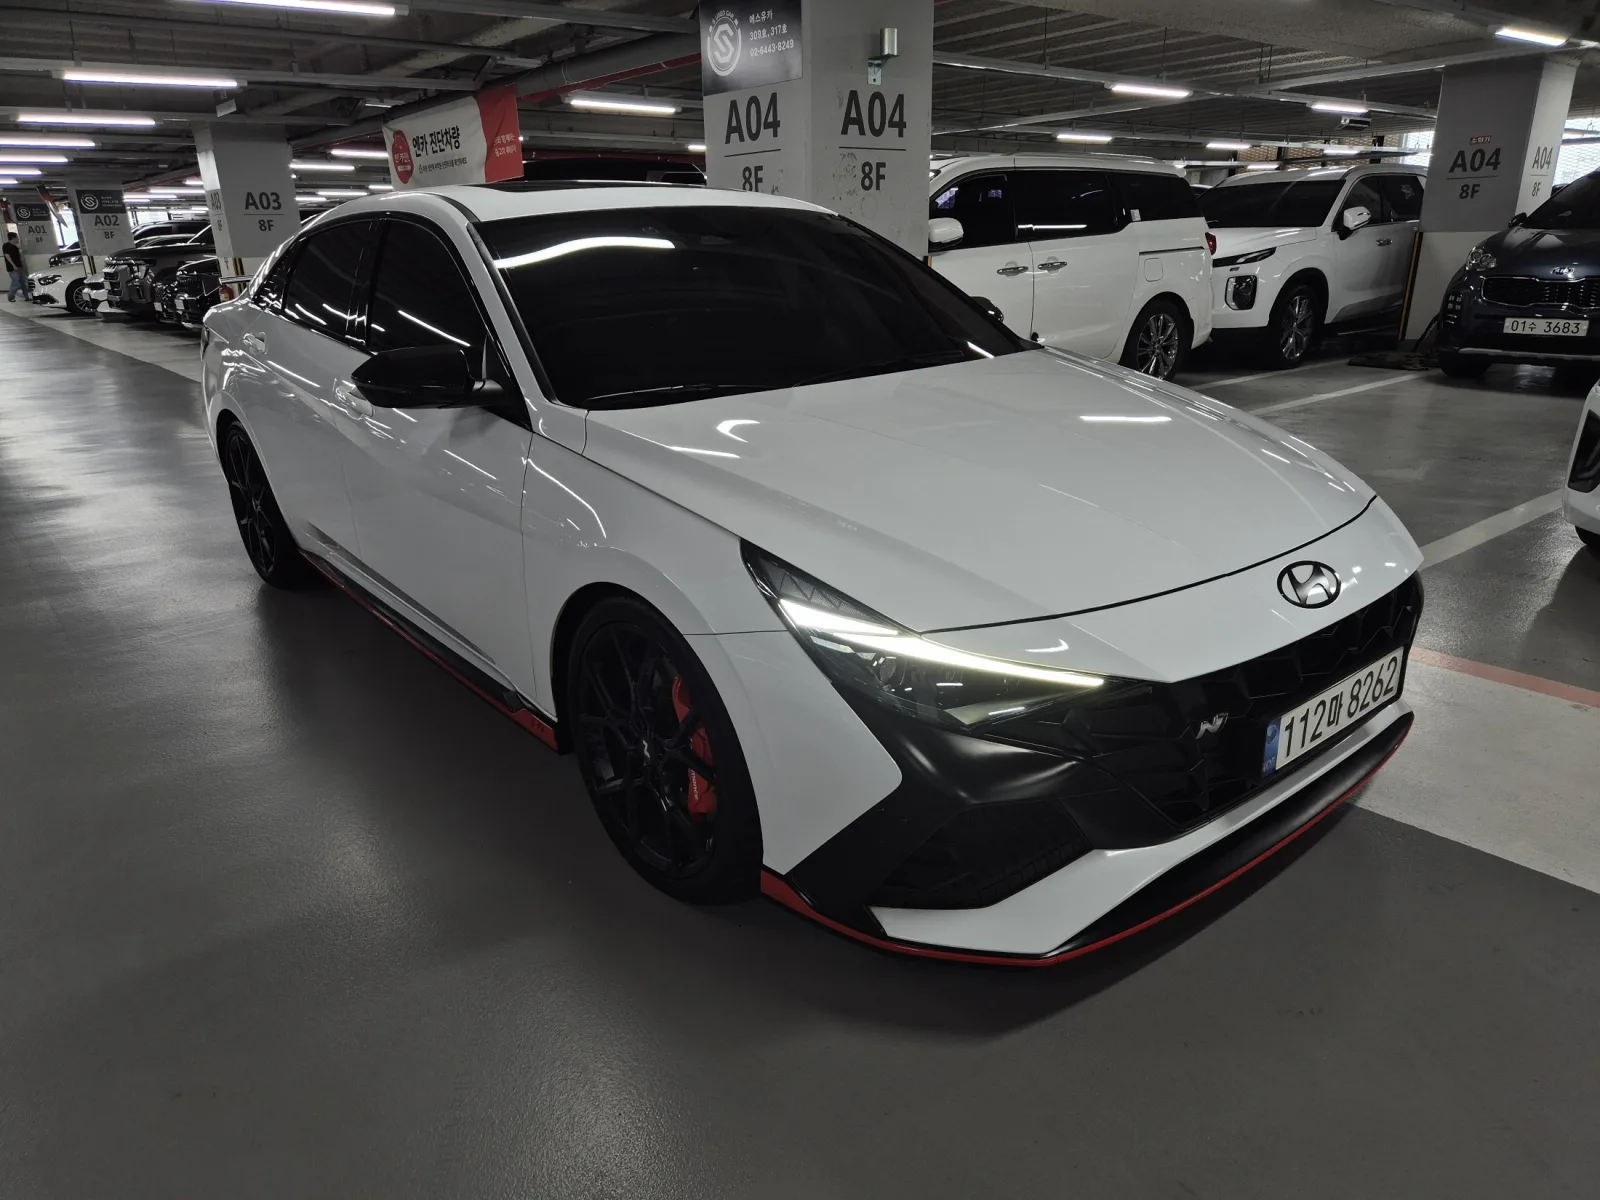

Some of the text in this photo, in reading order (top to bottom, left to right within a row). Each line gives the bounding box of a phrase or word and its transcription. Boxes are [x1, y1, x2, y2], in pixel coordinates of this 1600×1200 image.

[771, 24, 788, 36] 317호
[724, 92, 780, 144] A04
[840, 90, 906, 138] A04
[412, 125, 461, 157] 엔카 진단차량
[1448, 148, 1501, 173] A04
[1532, 146, 1552, 169] A04
[742, 166, 764, 192] 8F
[861, 161, 886, 190] 8F
[1459, 184, 1480, 199] 8F
[1531, 182, 1541, 197] 8F
[244, 192, 282, 211] A03
[28, 225, 47, 234] A01
[94, 214, 120, 227] A02
[259, 219, 274, 232] 8F
[104, 231, 115, 240] 8F
[1510, 320, 1580, 334] 01수 3683
[1284, 656, 1398, 758] 112마 8262
